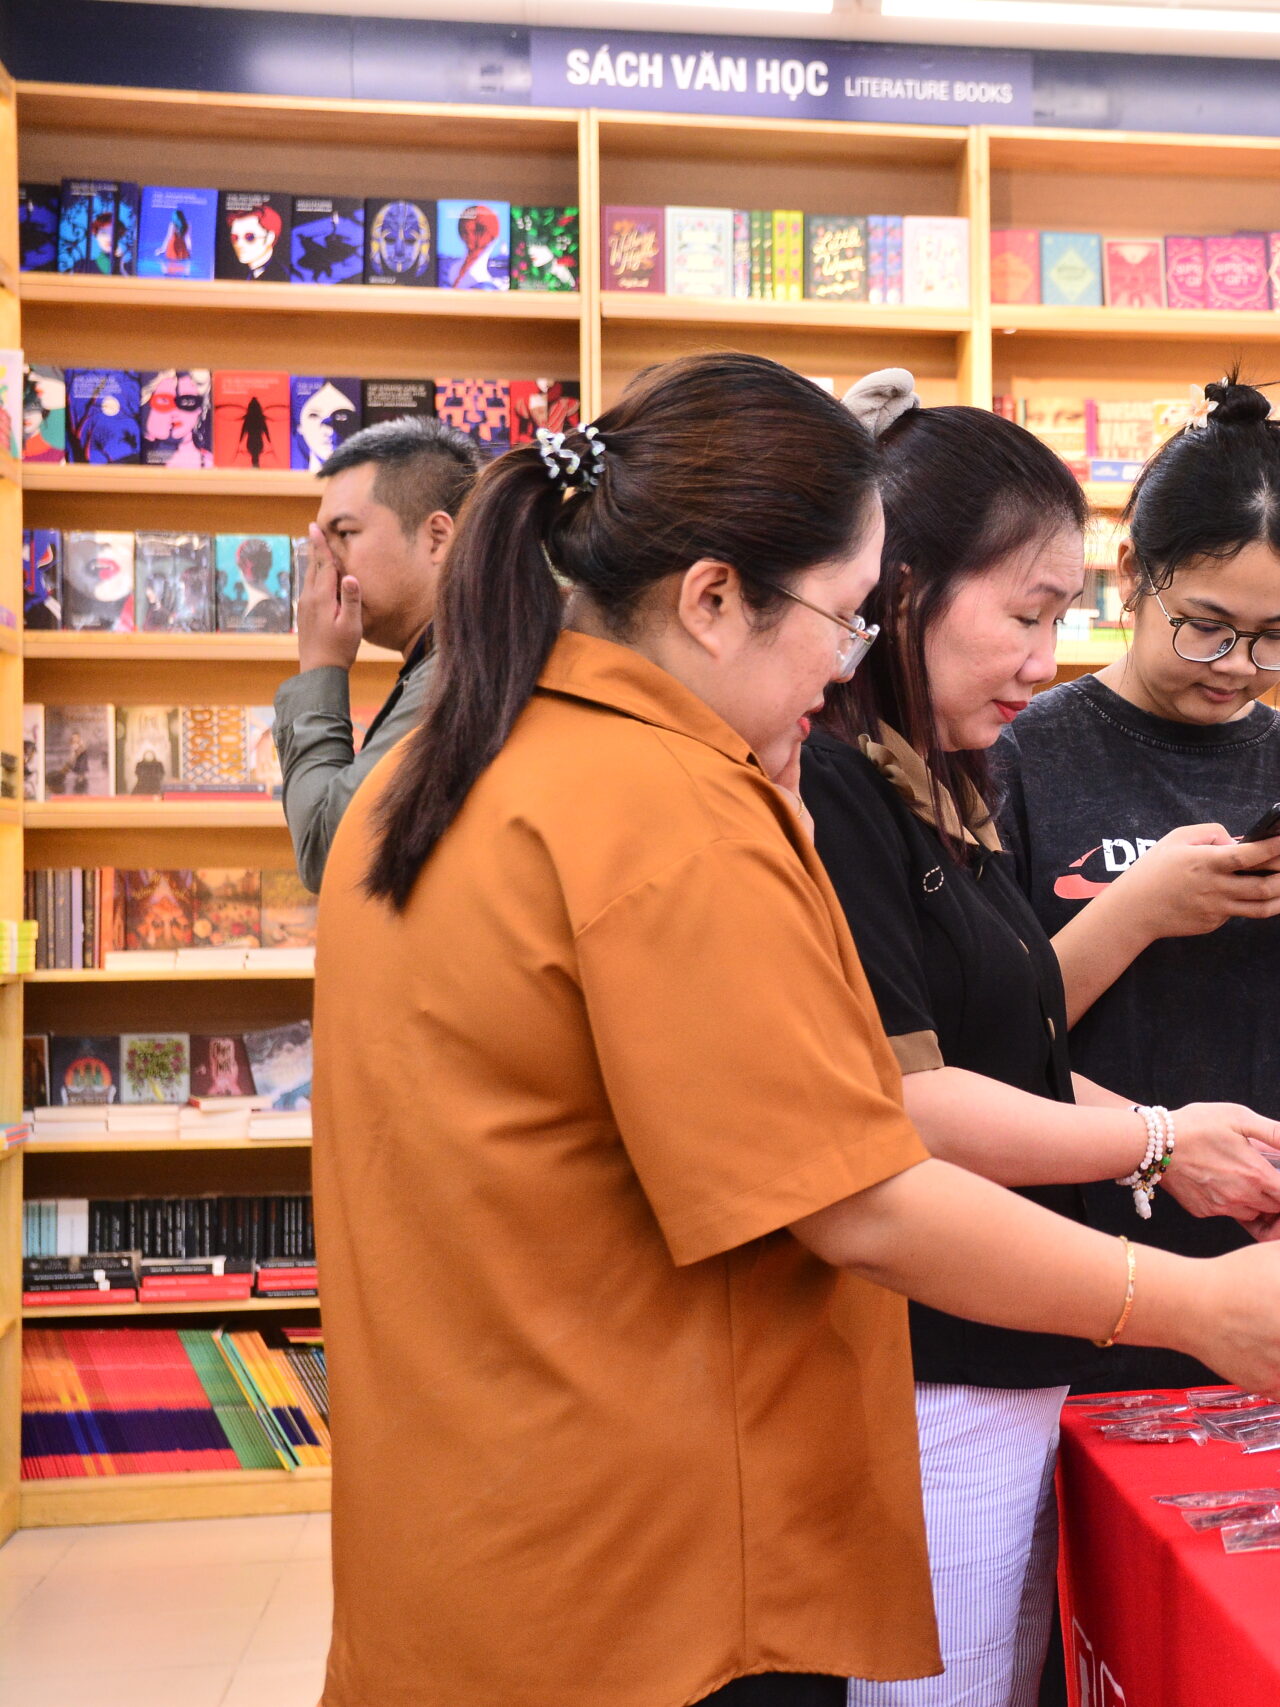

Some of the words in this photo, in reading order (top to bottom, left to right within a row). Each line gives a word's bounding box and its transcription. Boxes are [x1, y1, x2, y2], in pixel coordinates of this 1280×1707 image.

[566, 44, 663, 88] SÁCH
[670, 51, 747, 92] VĂN
[755, 58, 829, 101] HỌC
[844, 76, 950, 100] LITERATURE
[953, 81, 1013, 104] BOOKS
